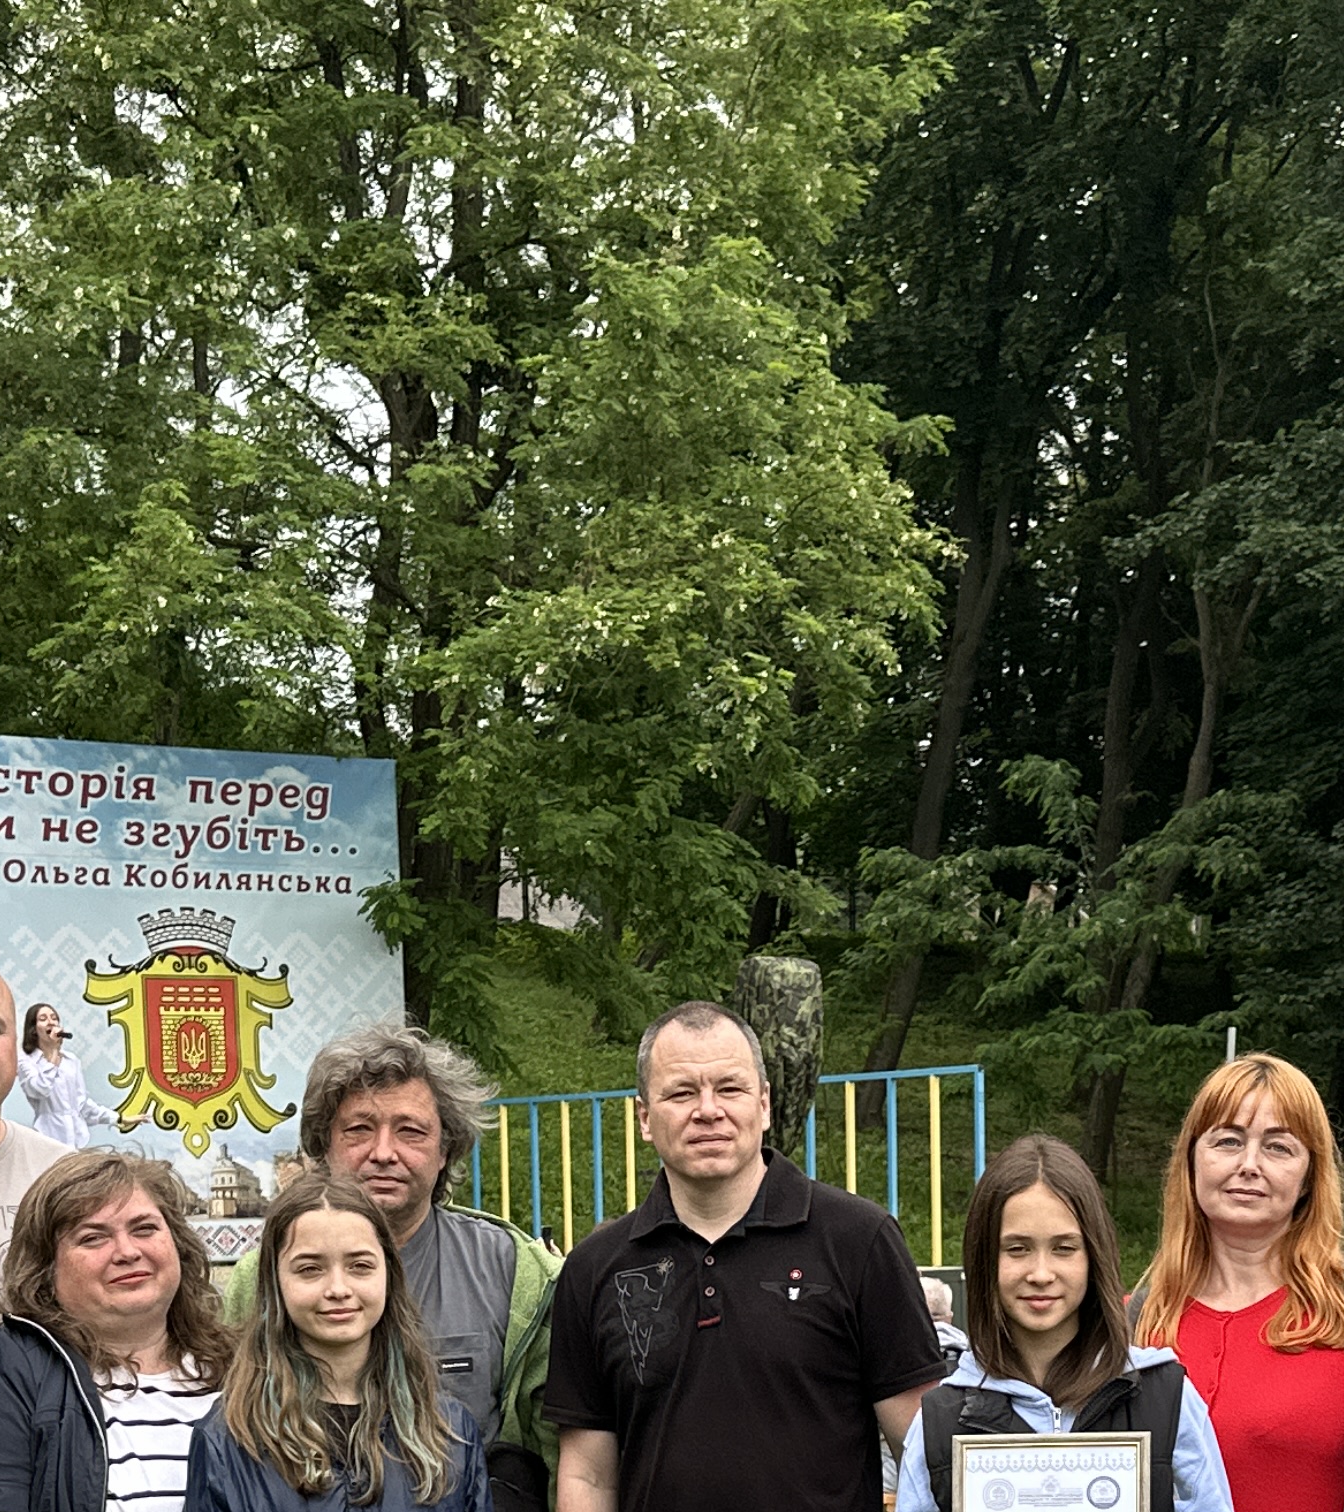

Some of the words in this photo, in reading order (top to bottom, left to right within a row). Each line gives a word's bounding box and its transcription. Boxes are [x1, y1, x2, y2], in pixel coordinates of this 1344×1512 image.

[189, 777, 330, 819] перед
[42, 816, 99, 845] не
[123, 815, 359, 858] згубіть...
[3, 859, 111, 887] Ольга
[123, 862, 353, 895] Кобилянська
